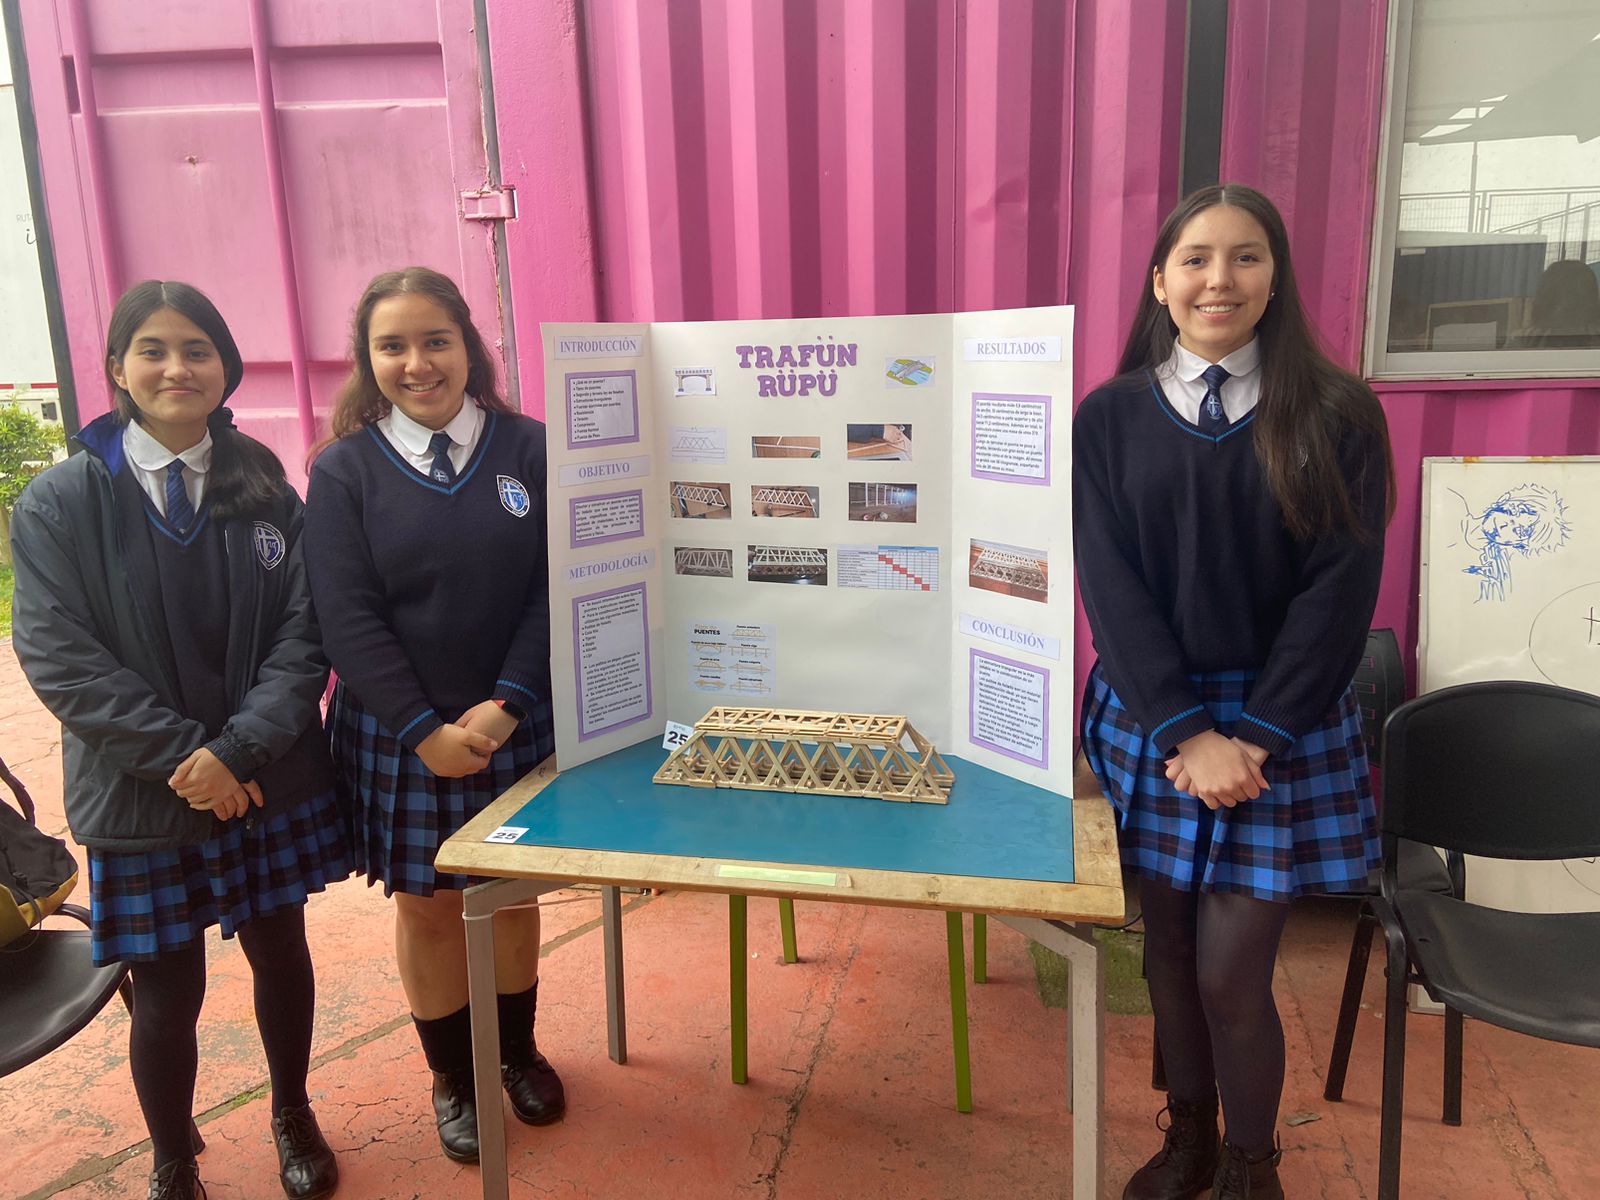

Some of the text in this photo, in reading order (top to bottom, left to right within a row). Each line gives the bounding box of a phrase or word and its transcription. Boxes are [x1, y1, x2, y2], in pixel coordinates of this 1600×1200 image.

[560, 337, 637, 353] INTRODUCCIÓN
[735, 335, 857, 369] TRAFÜN
[977, 342, 1047, 355] RESULTADOS
[757, 369, 838, 397] RÜPÜ
[579, 462, 630, 478] OBJETIVO
[569, 553, 648, 580] METODOLOGÍA
[972, 620, 1045, 649] CONCLUSIÓN
[492, 832, 519, 840] 25
